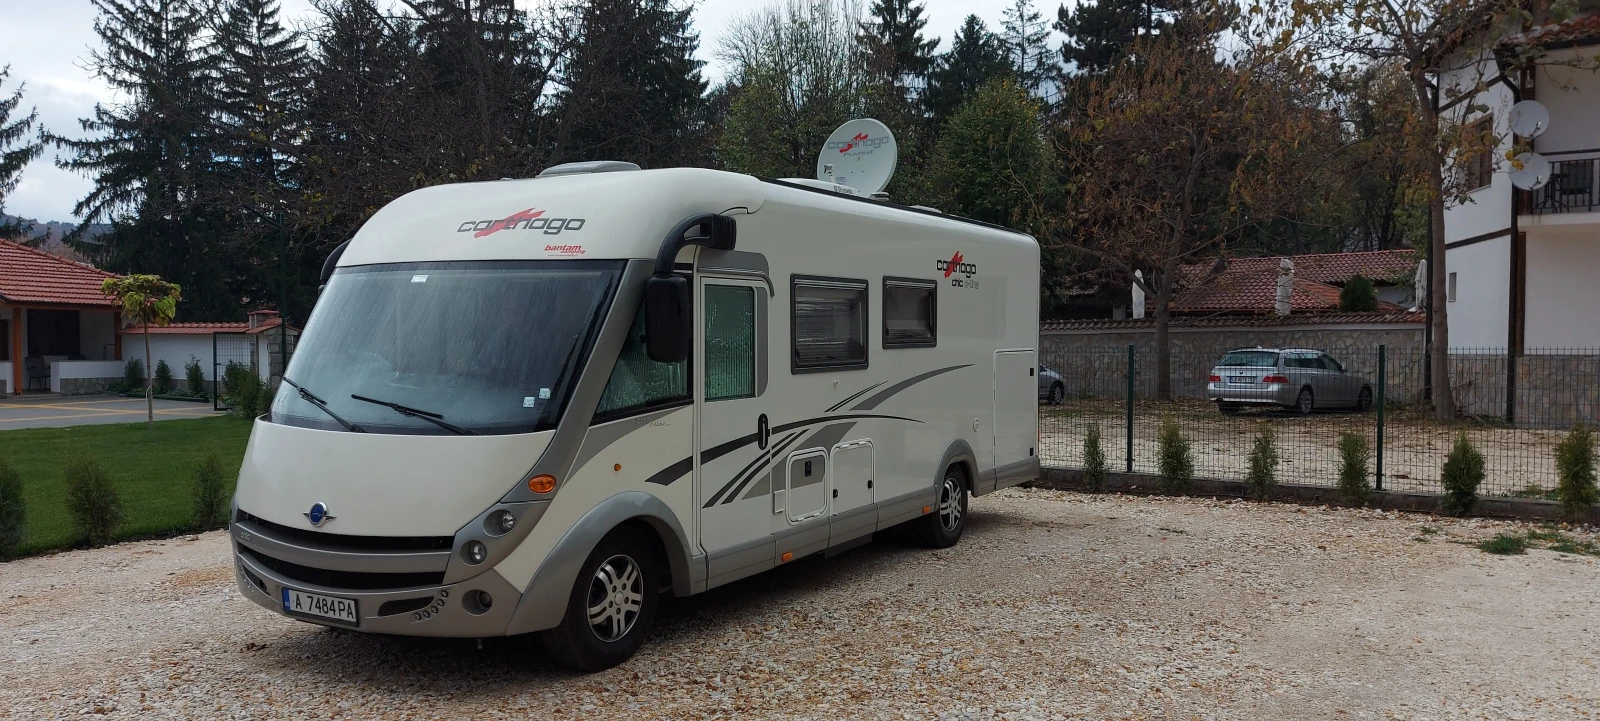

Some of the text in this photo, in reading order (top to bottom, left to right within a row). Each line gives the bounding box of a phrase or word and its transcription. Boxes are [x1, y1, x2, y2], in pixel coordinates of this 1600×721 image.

[827, 136, 889, 150] carthago
[457, 216, 586, 235] carthago
[936, 259, 977, 278] carthago
[295, 593, 303, 610] A
